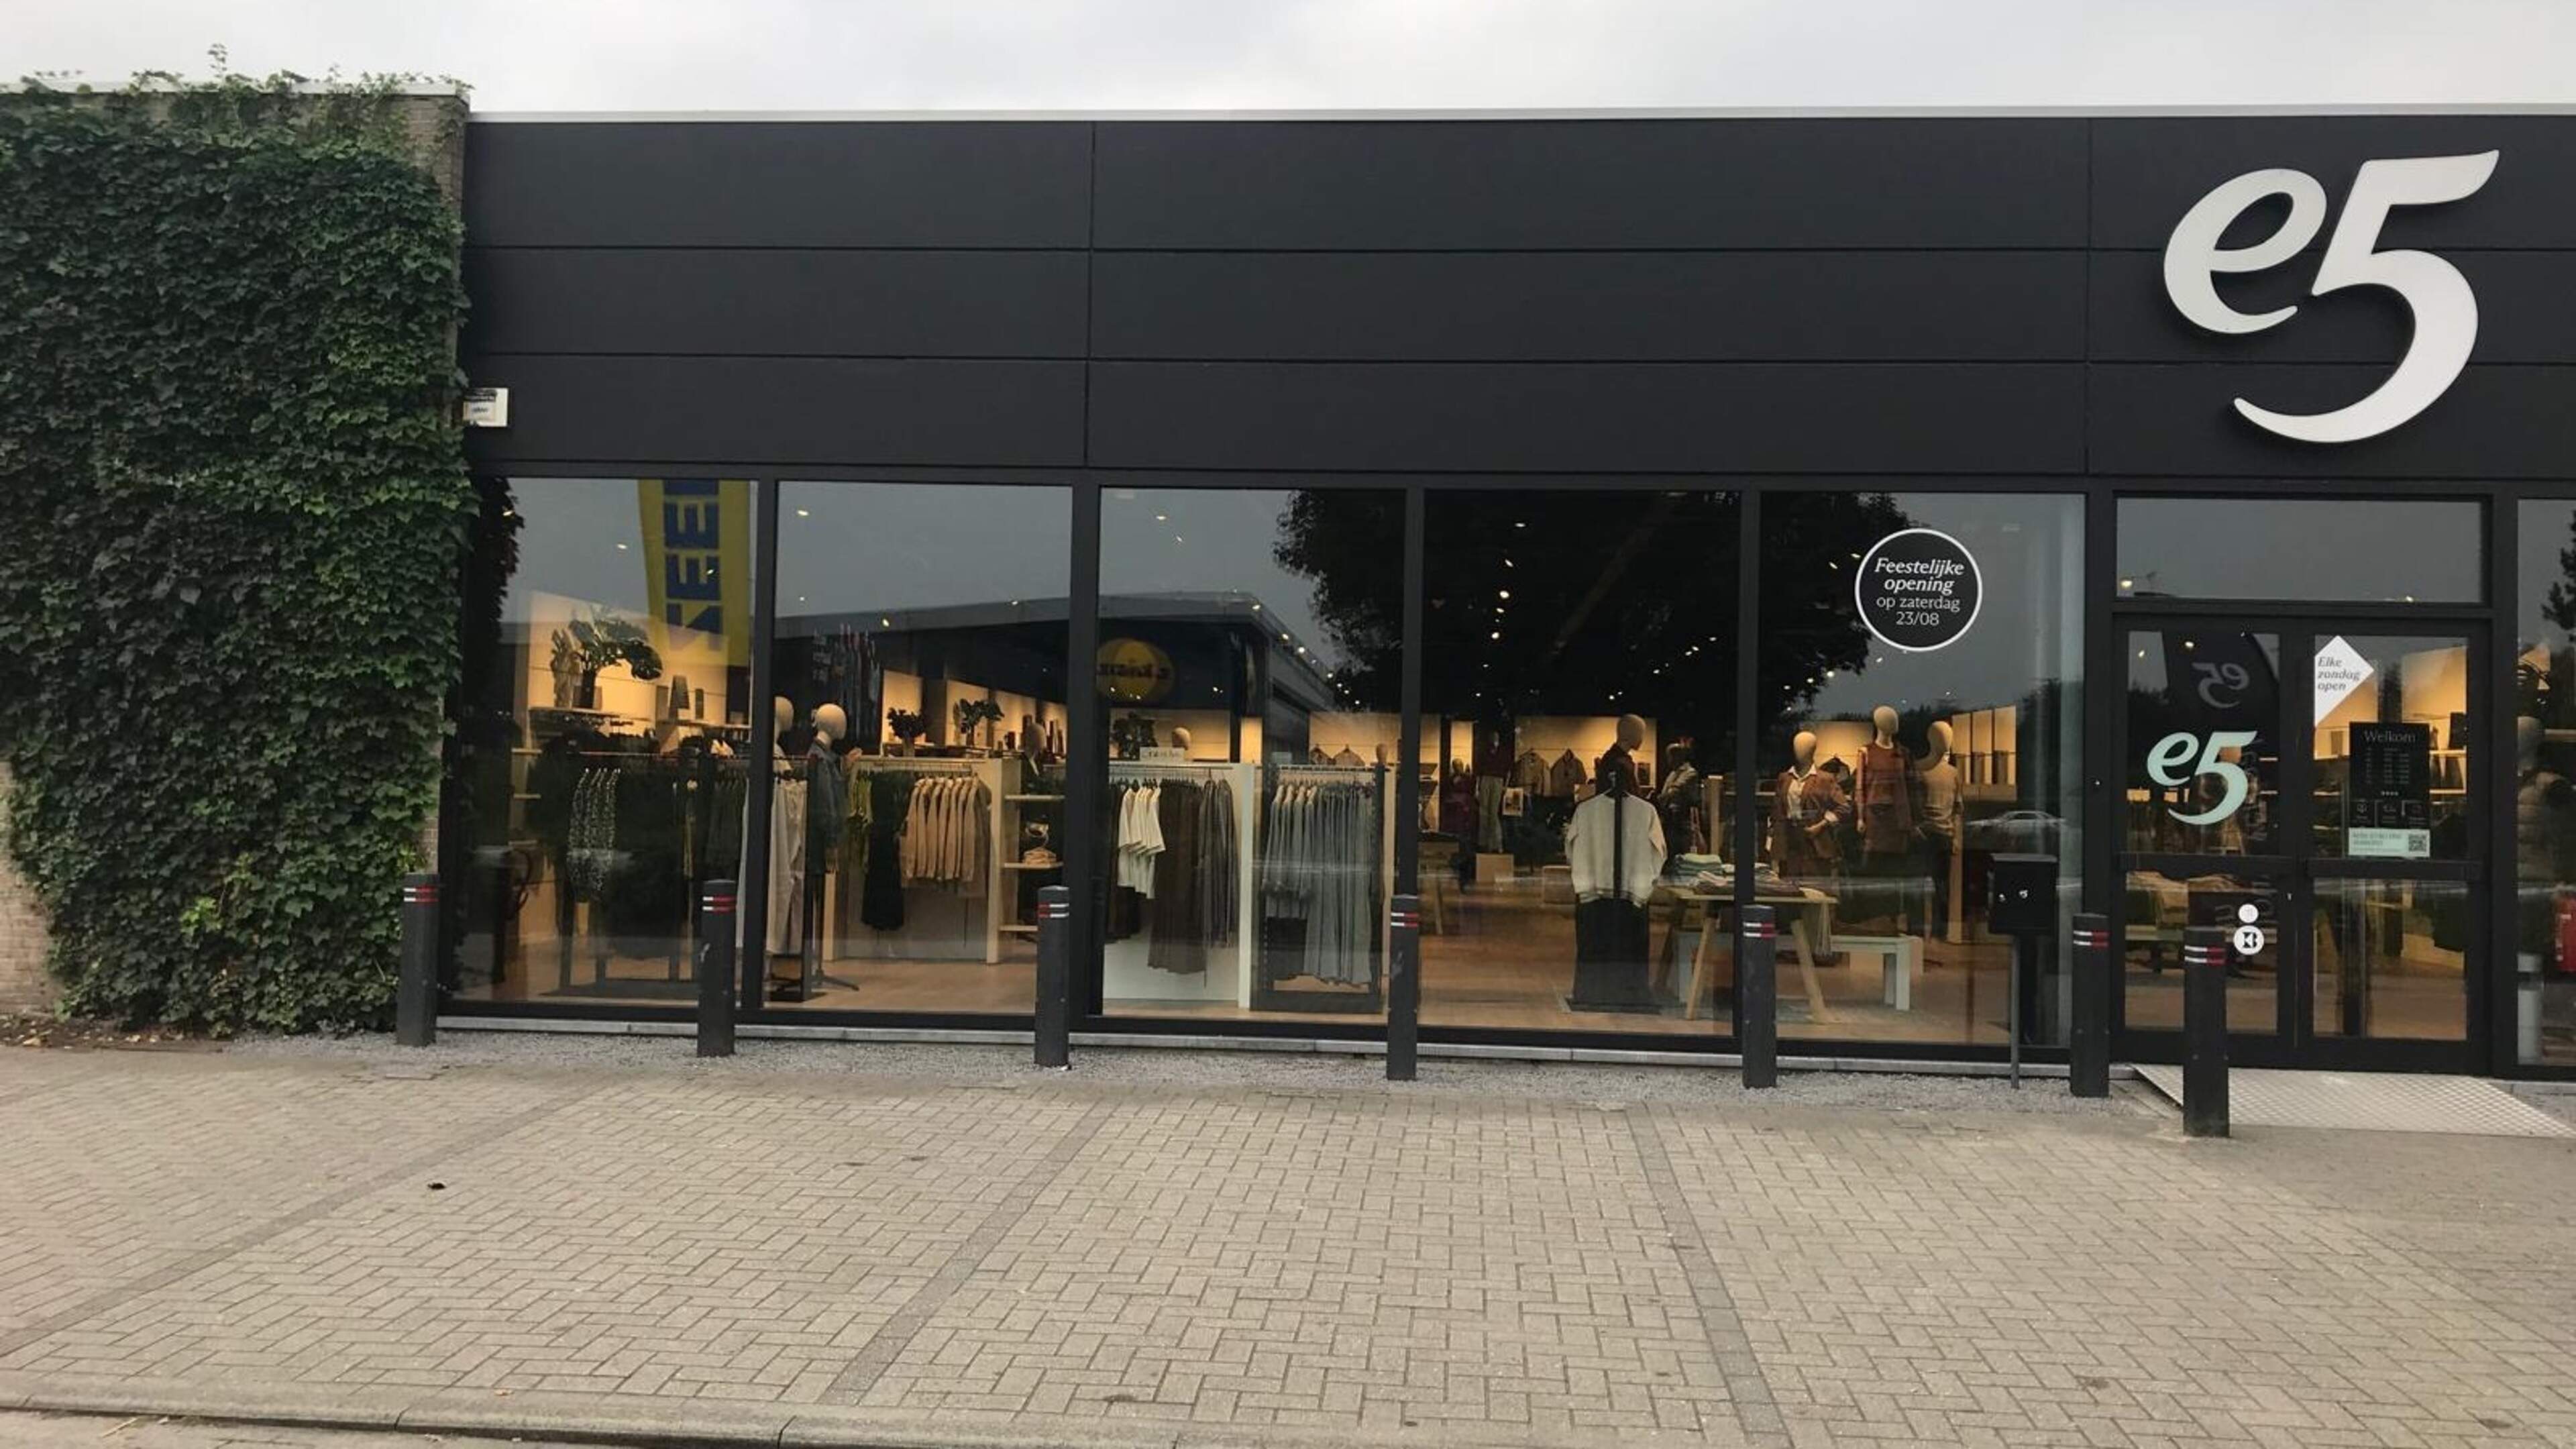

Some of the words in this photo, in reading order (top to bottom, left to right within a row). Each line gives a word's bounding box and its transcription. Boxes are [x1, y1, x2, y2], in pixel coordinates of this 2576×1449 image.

[2164, 149, 2500, 443] e5
[1874, 557, 1965, 579] Feestelijke
[1884, 576, 1955, 596] opening
[1876, 596, 1896, 611] op
[1899, 596, 1961, 613] zaterdag
[1896, 611, 1939, 626] 23/08
[2318, 657, 2343, 667] Elke
[2318, 669, 2361, 682] zondag
[2318, 682, 2347, 692] open
[2363, 729, 2416, 743] Welkom
[2147, 730, 2258, 825] e5
